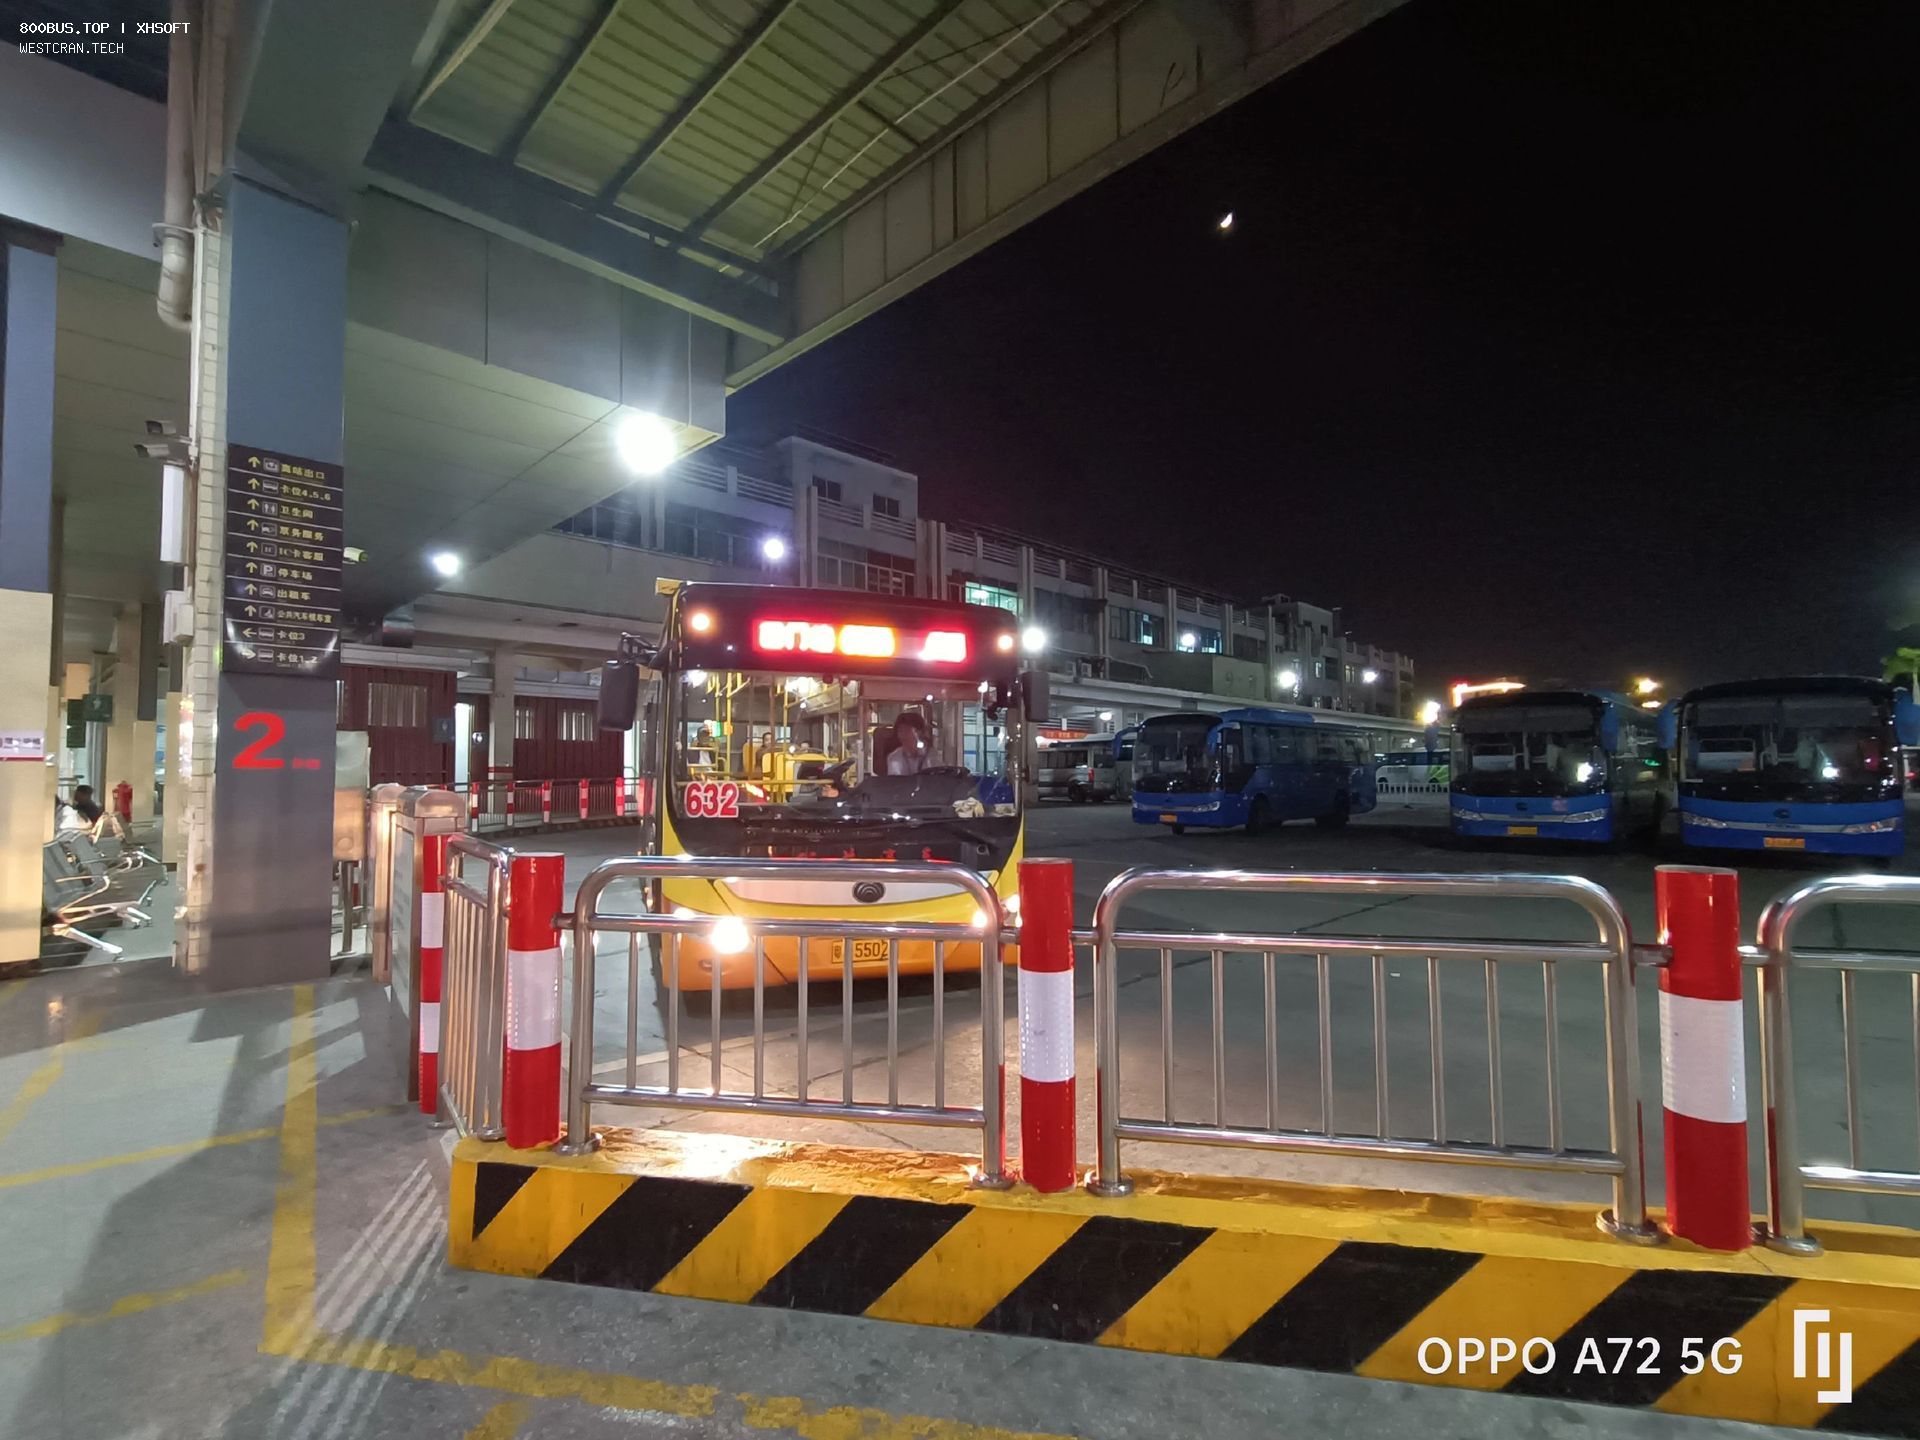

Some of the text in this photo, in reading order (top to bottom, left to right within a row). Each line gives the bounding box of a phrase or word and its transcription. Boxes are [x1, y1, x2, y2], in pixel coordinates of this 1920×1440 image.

[281, 505, 314, 519] 卫生间
[278, 568, 313, 580] 停车场
[277, 589, 311, 600] 出租车
[232, 711, 286, 769] 2
[684, 781, 739, 817] 632
